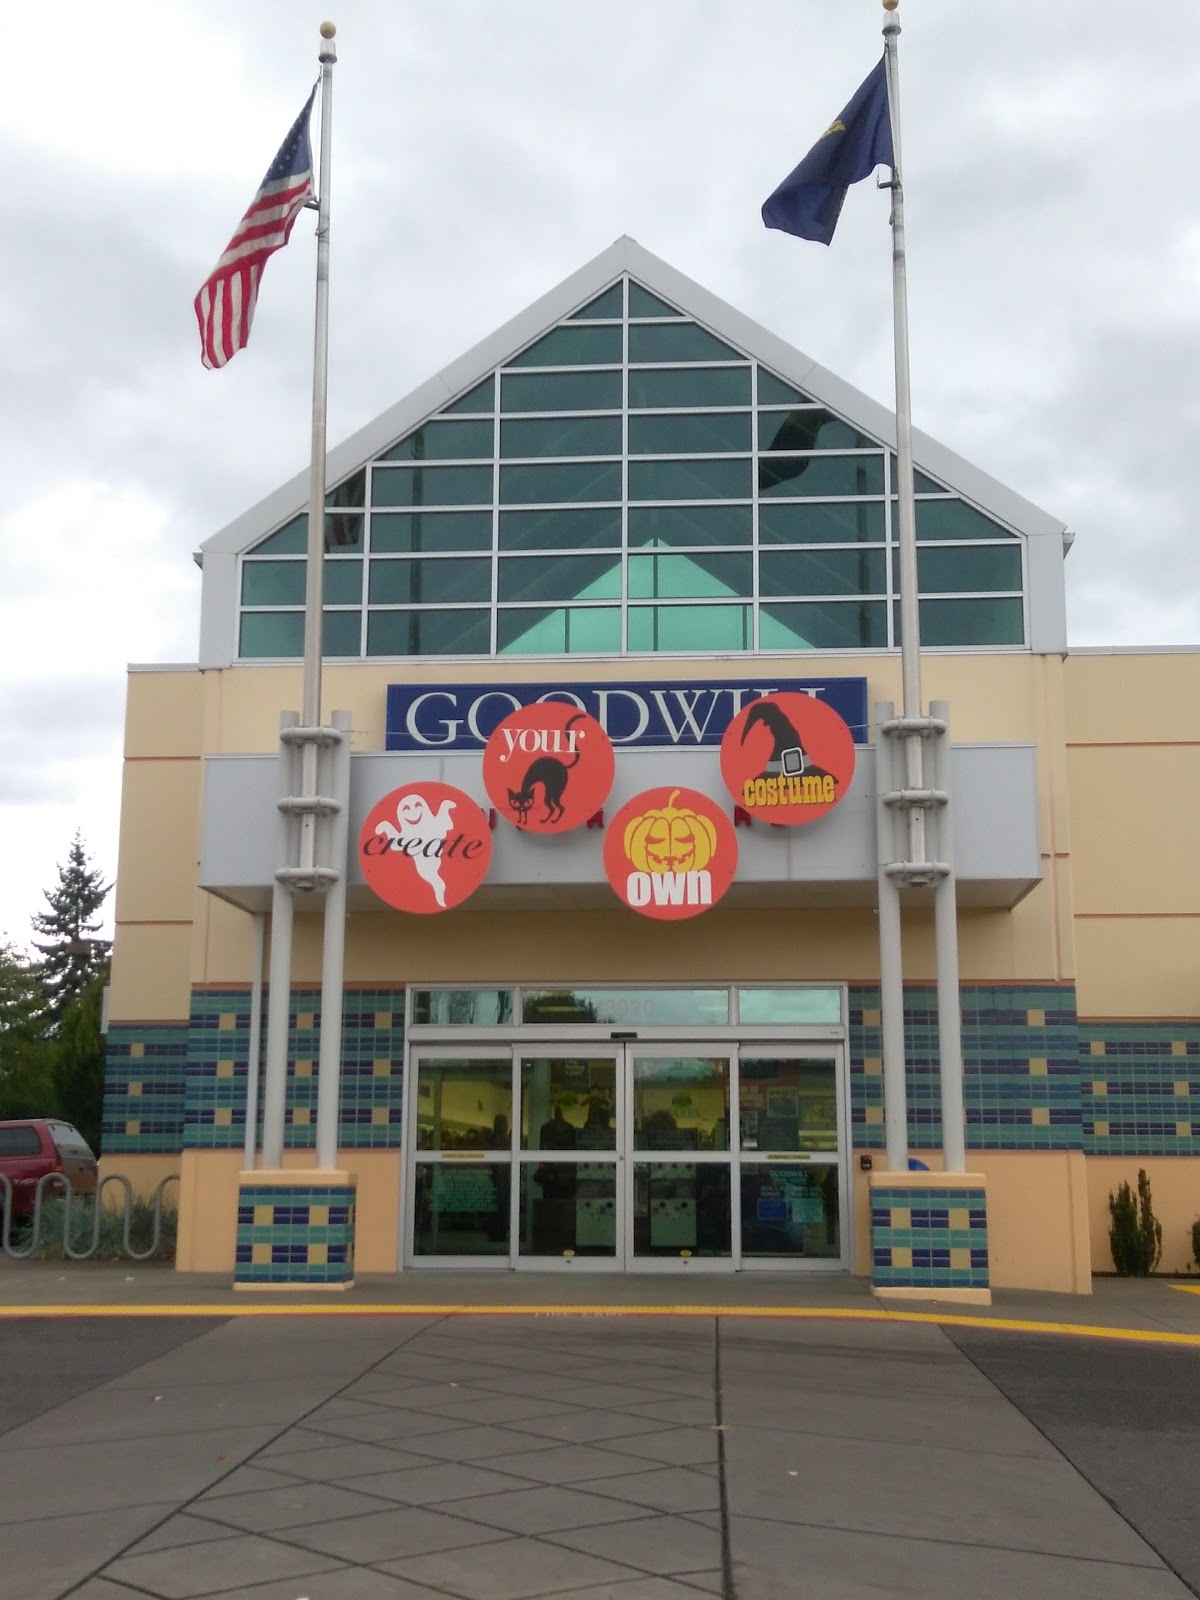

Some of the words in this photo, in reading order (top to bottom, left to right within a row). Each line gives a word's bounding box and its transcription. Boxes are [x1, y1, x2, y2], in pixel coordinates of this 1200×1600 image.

[405, 687, 826, 746] GODWI
[500, 728, 586, 762] your
[743, 770, 835, 807] costume
[363, 834, 485, 859] create
[626, 869, 713, 907] own
